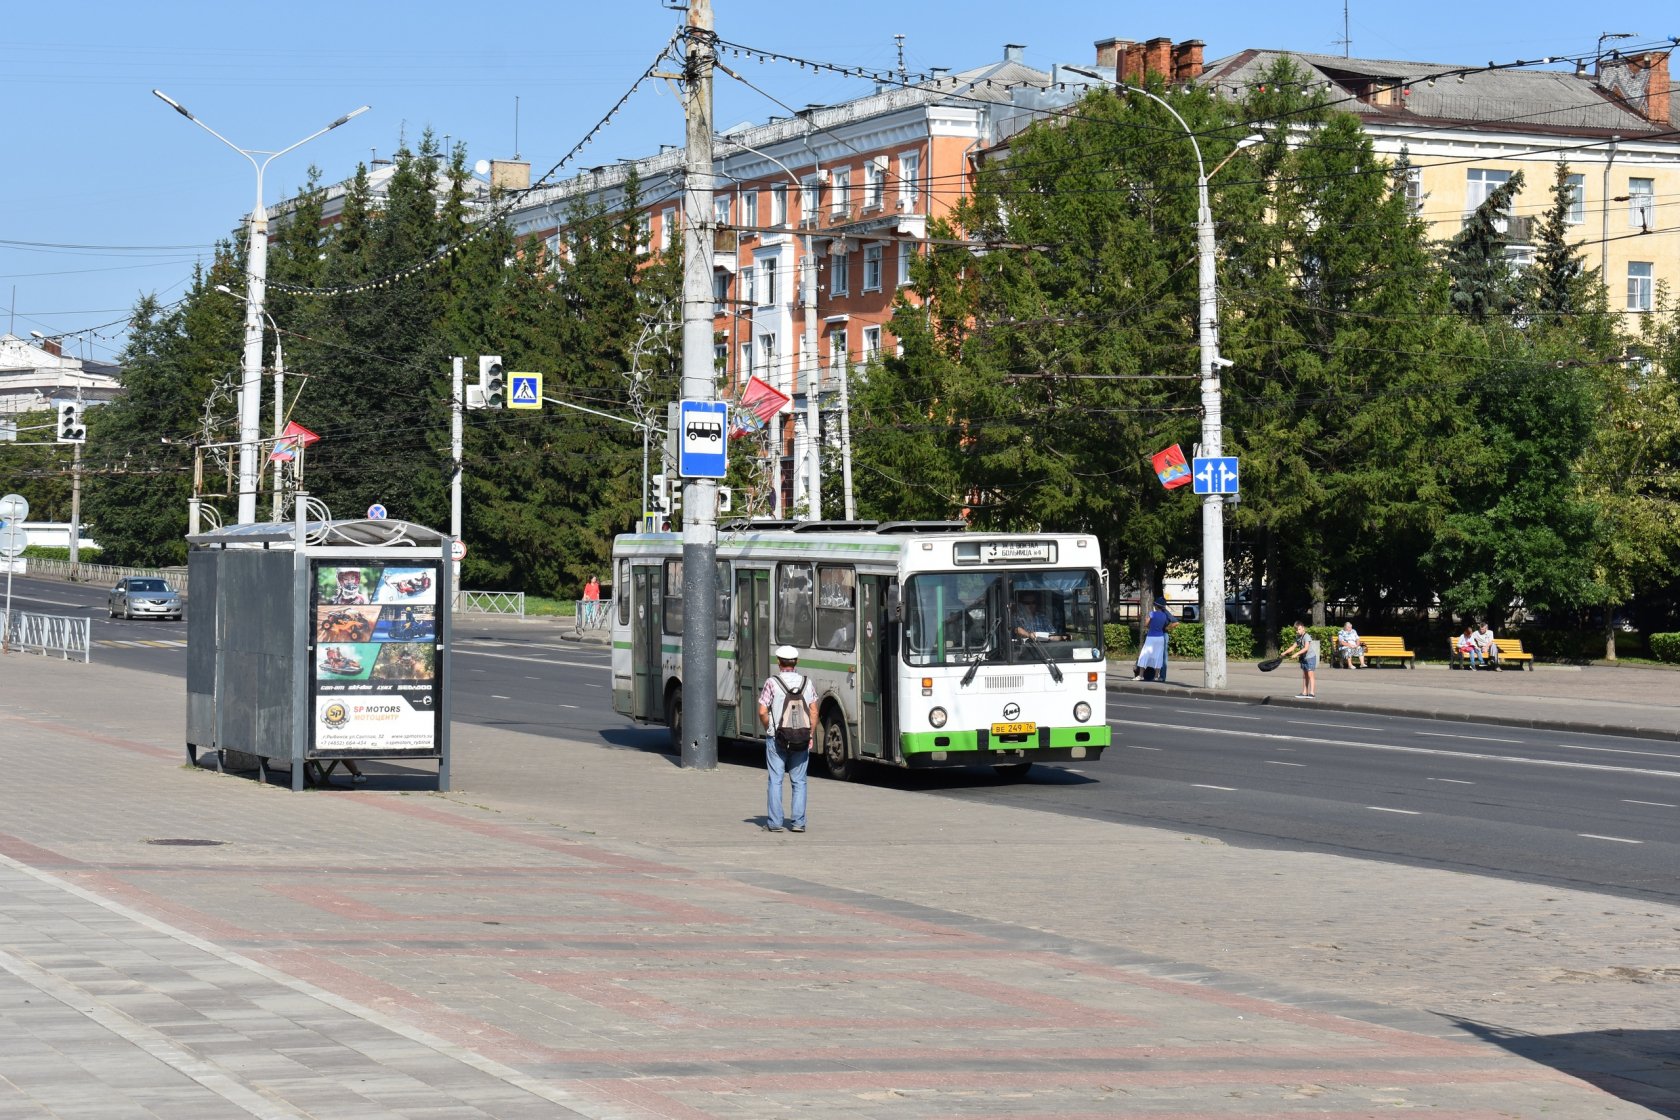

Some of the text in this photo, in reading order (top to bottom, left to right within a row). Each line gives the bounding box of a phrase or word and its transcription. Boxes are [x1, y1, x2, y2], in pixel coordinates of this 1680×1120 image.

[1001, 549, 1032, 557] БОЛЬНИЦА
[354, 705, 401, 713] SP MOTORS
[354, 713, 400, 722] МОТОЦЕНТР
[1008, 724, 1023, 733] 249
